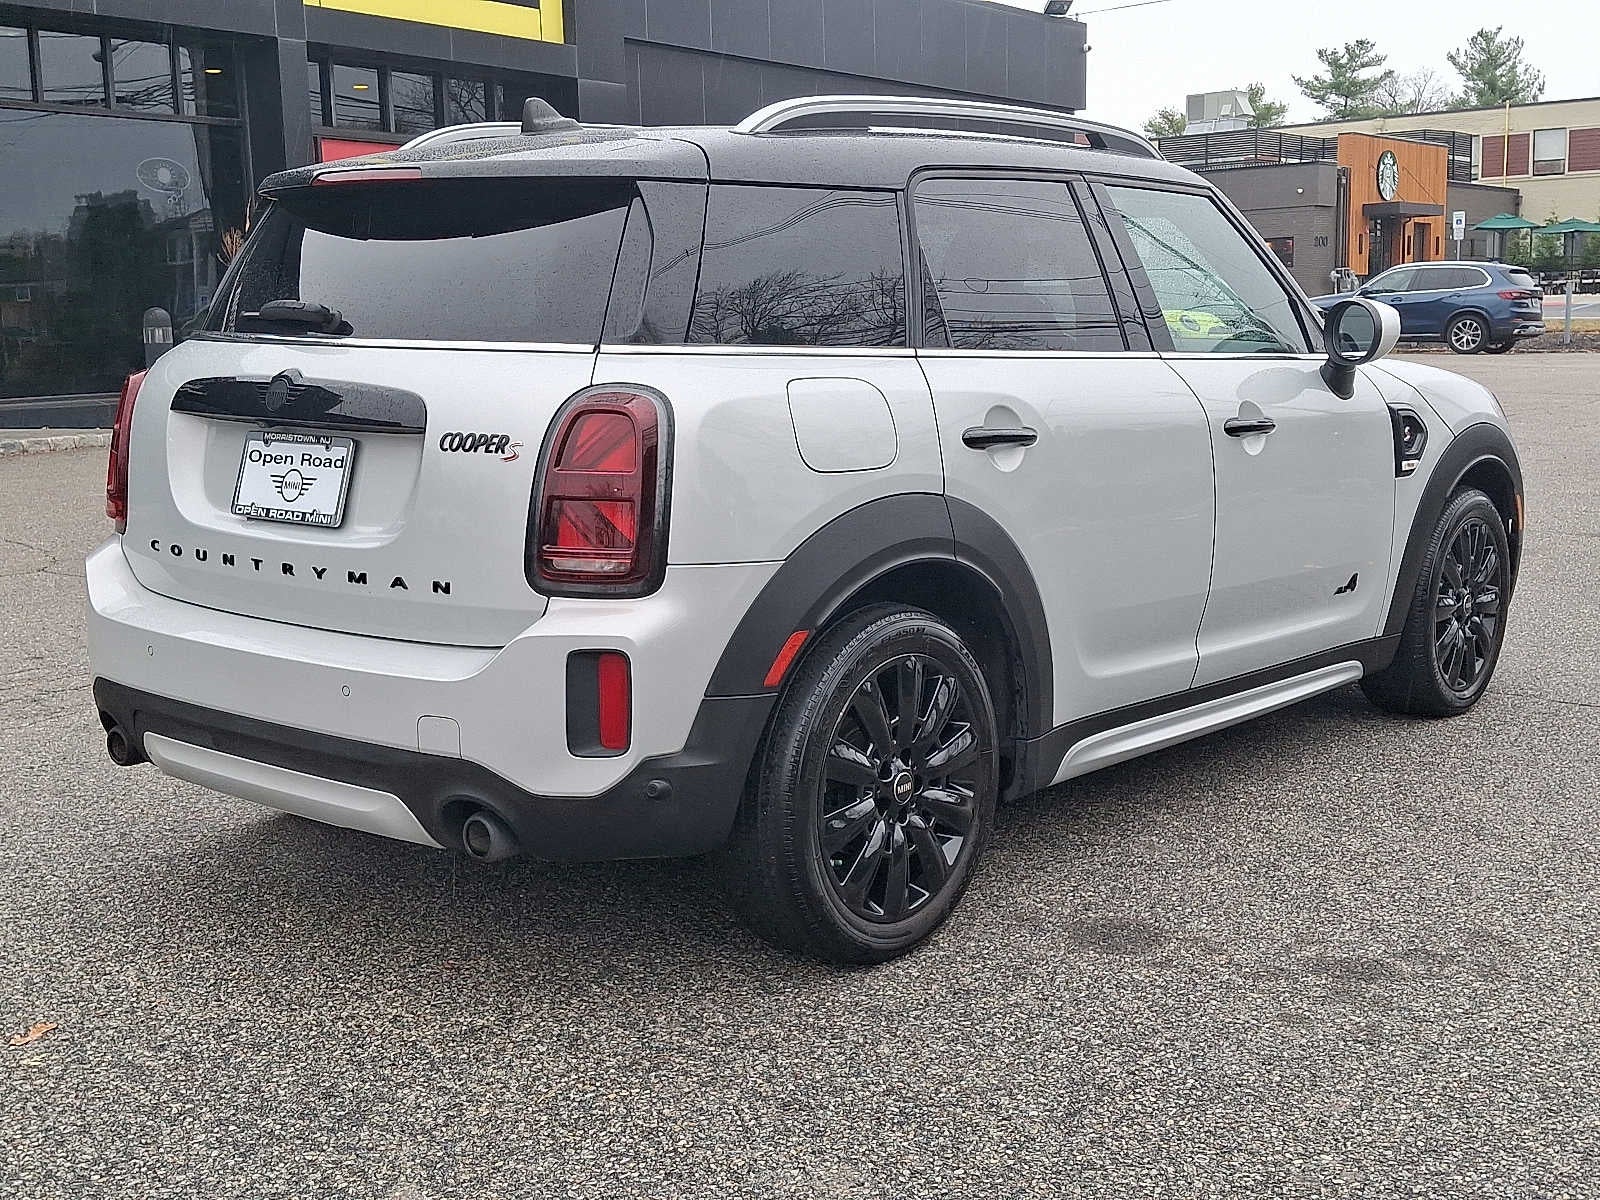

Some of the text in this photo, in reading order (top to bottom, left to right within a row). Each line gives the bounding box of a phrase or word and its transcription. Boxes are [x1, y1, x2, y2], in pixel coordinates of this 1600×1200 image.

[320, 436, 331, 444] NJ
[439, 432, 524, 462] COOPER S
[249, 449, 345, 468] Open Road
[284, 480, 301, 491] MINI
[235, 505, 331, 524] OPEN ROAD MINI
[150, 540, 451, 595] COUNTRYMAN
[897, 782, 912, 794] MINI
